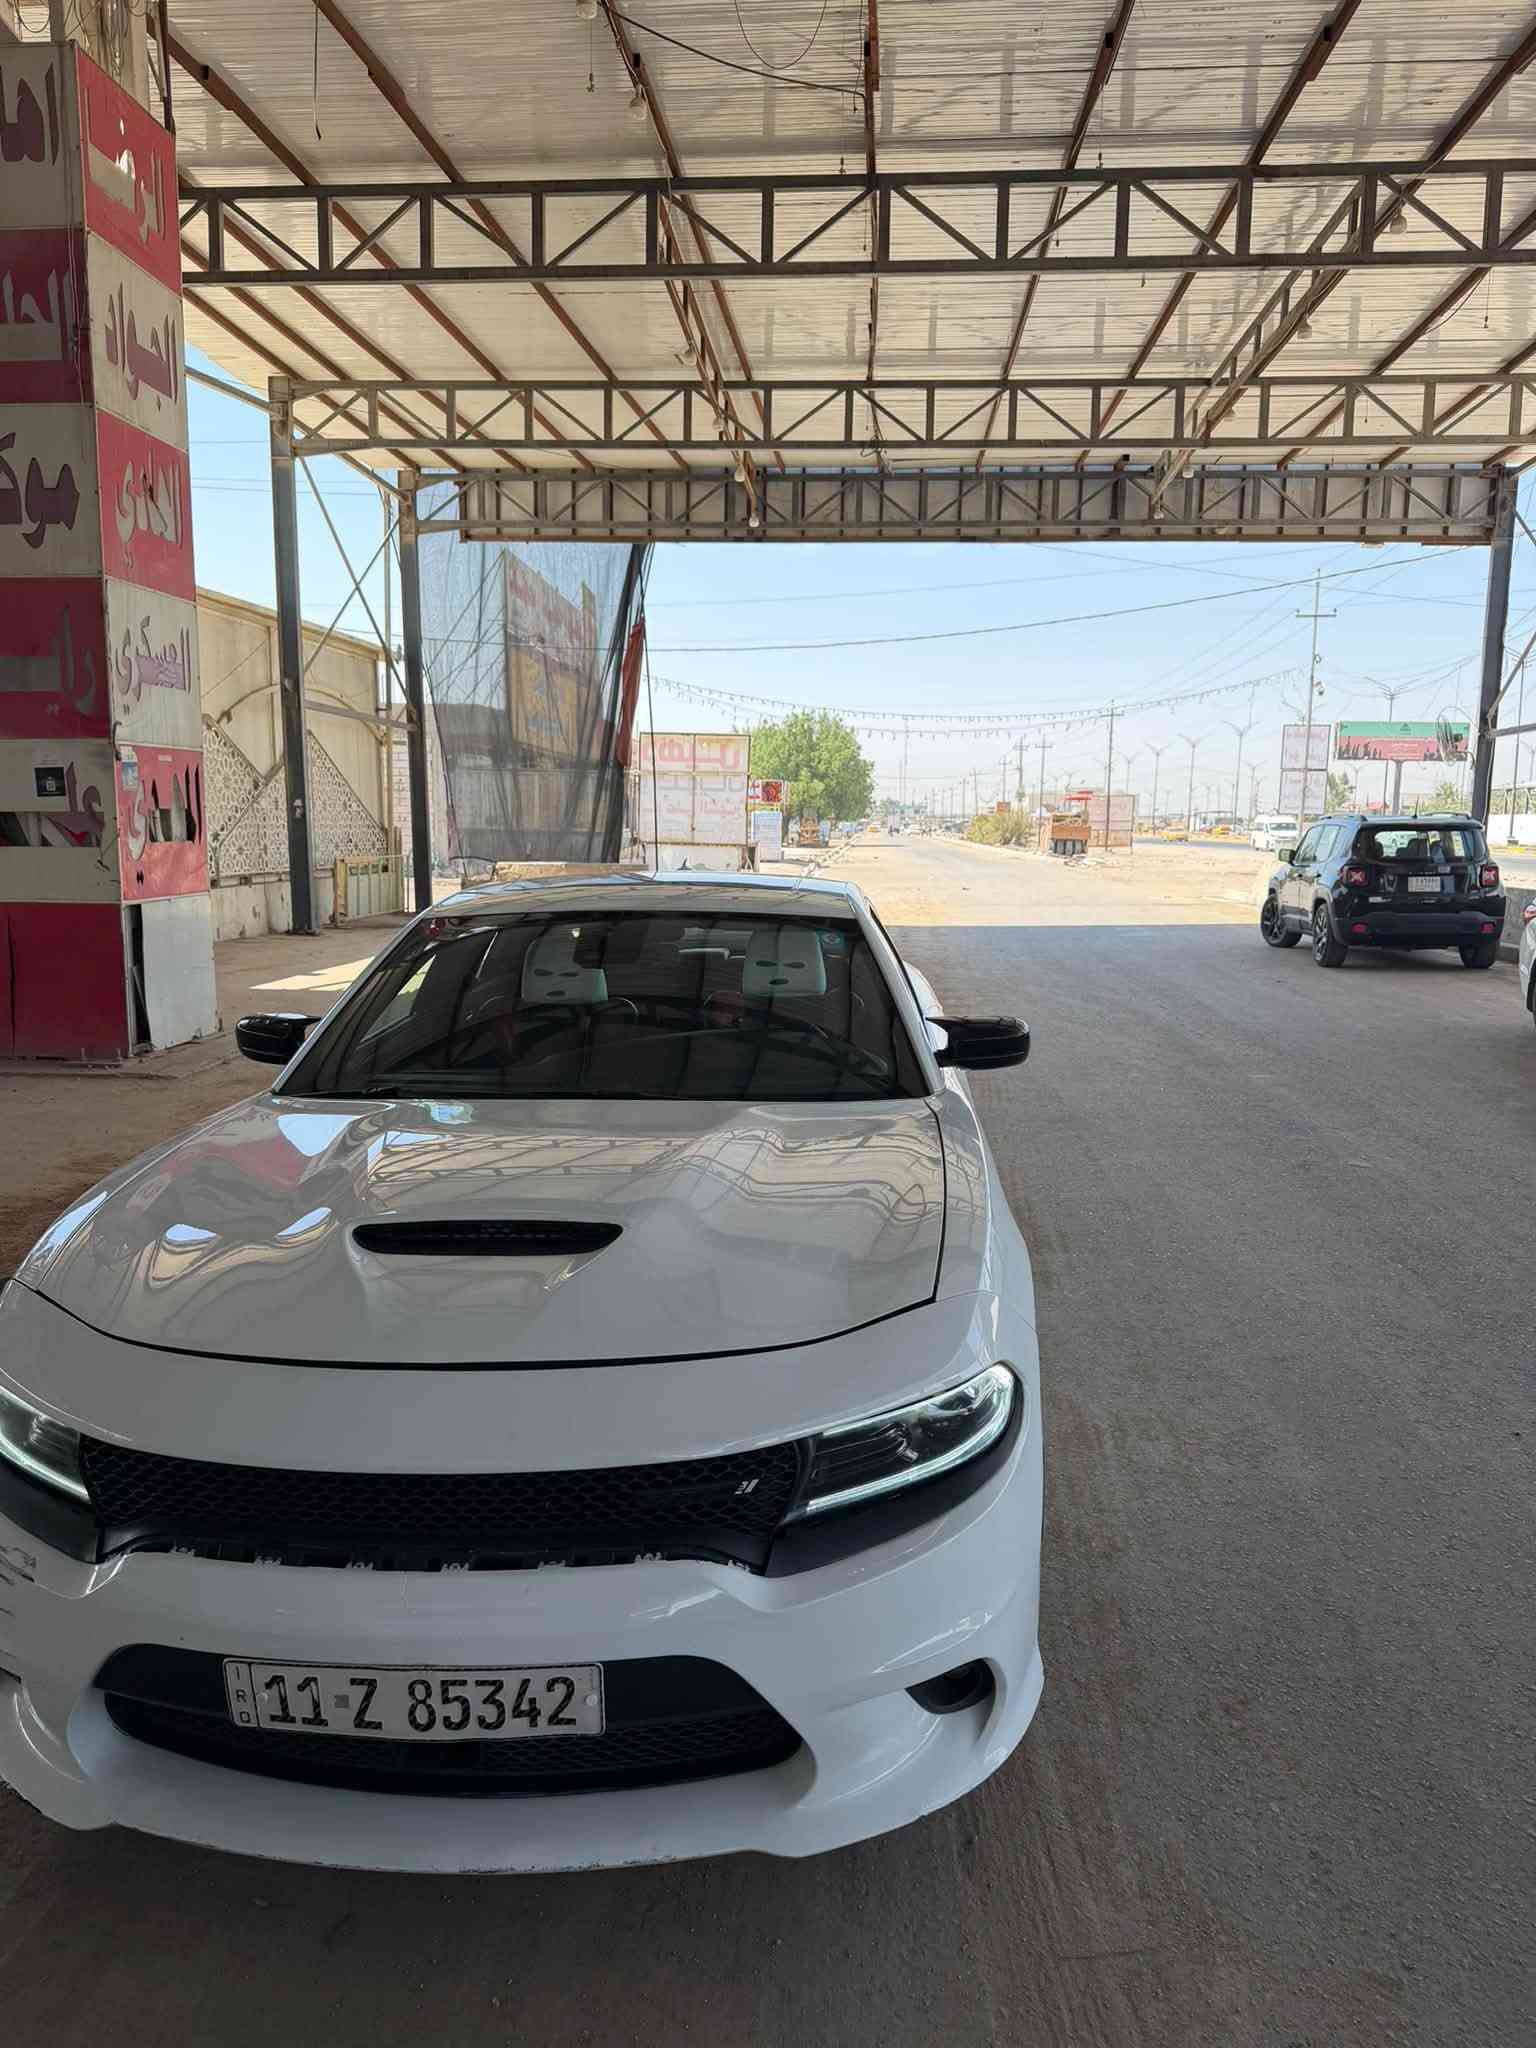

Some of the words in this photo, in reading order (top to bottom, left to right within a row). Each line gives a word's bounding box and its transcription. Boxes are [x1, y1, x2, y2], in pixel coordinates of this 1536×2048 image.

[104, 281, 178, 411] الجواد
[115, 615, 191, 716] العسكري
[264, 1674, 328, 1727] 11
[349, 1677, 383, 1731] Z
[407, 1676, 577, 1732] 85342
